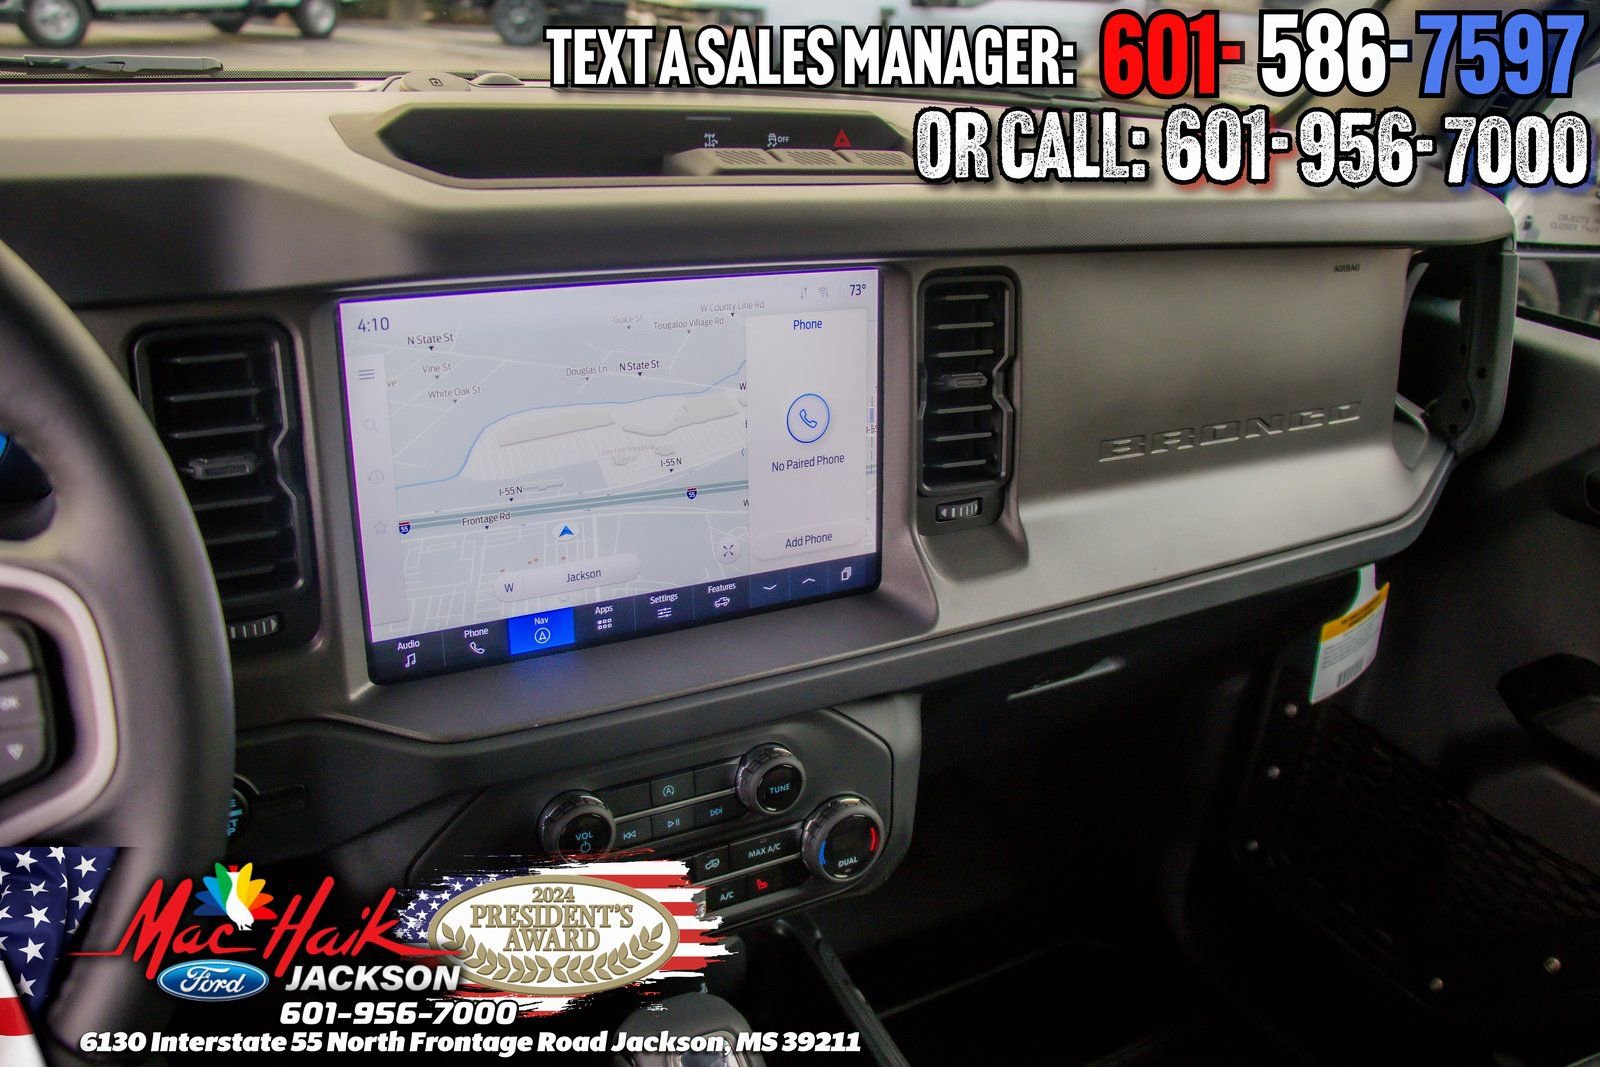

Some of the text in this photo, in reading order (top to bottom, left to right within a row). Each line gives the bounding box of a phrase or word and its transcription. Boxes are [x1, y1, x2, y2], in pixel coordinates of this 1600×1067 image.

[777, 135, 790, 144] OFF
[1333, 264, 1360, 273] AIRBAG
[849, 284, 867, 297] 73°
[700, 299, 765, 313] W County Line Rd
[357, 316, 390, 333] 4:10
[634, 314, 643, 323] St
[653, 317, 725, 331] Tougaloo Village Rd
[793, 318, 823, 331] Phone
[407, 332, 454, 346] N State St
[421, 362, 451, 374] Vine St
[565, 364, 608, 377] Douglas Ln
[619, 359, 660, 372] N State St
[427, 384, 482, 399] White Oak St
[660, 457, 683, 468] I-55 N
[771, 453, 846, 472] No Paired Phone
[499, 485, 524, 497] I-55 N
[688, 491, 697, 499] 55
[461, 511, 511, 527] Frontage Rd
[400, 525, 410, 534] 55
[785, 533, 834, 549] Add Phone
[566, 569, 602, 583] Jackson
[504, 583, 514, 593] W
[707, 582, 737, 594] Features
[650, 592, 679, 605] Settings
[594, 605, 614, 616] Apps
[534, 616, 549, 626] Nav
[463, 627, 489, 639] Phone
[397, 639, 421, 651] Audio
[769, 782, 791, 795] TUNE
[575, 831, 594, 842] VOL
[748, 842, 782, 858] MAX A/C
[838, 857, 859, 869] DUAL
[719, 891, 735, 902] A/C
